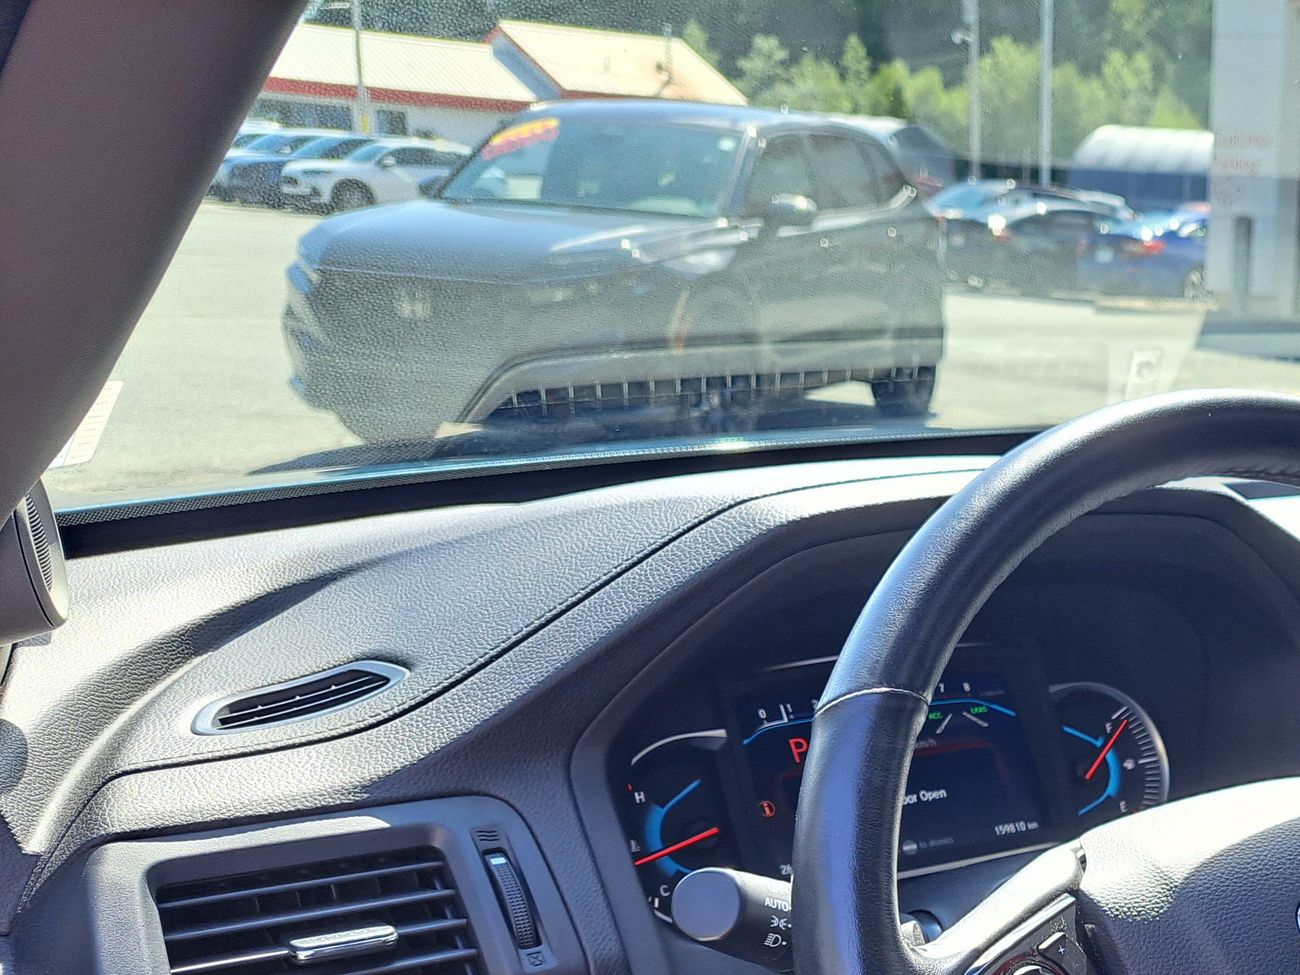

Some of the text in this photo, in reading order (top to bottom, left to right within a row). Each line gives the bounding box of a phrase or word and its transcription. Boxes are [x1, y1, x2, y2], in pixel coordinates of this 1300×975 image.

[1105, 723, 1112, 734] F
[788, 738, 809, 763] P
[634, 792, 645, 803] H
[919, 789, 947, 804] Open
[1119, 801, 1127, 812] E
[659, 885, 670, 897] C
[765, 897, 788, 912] AUTO
